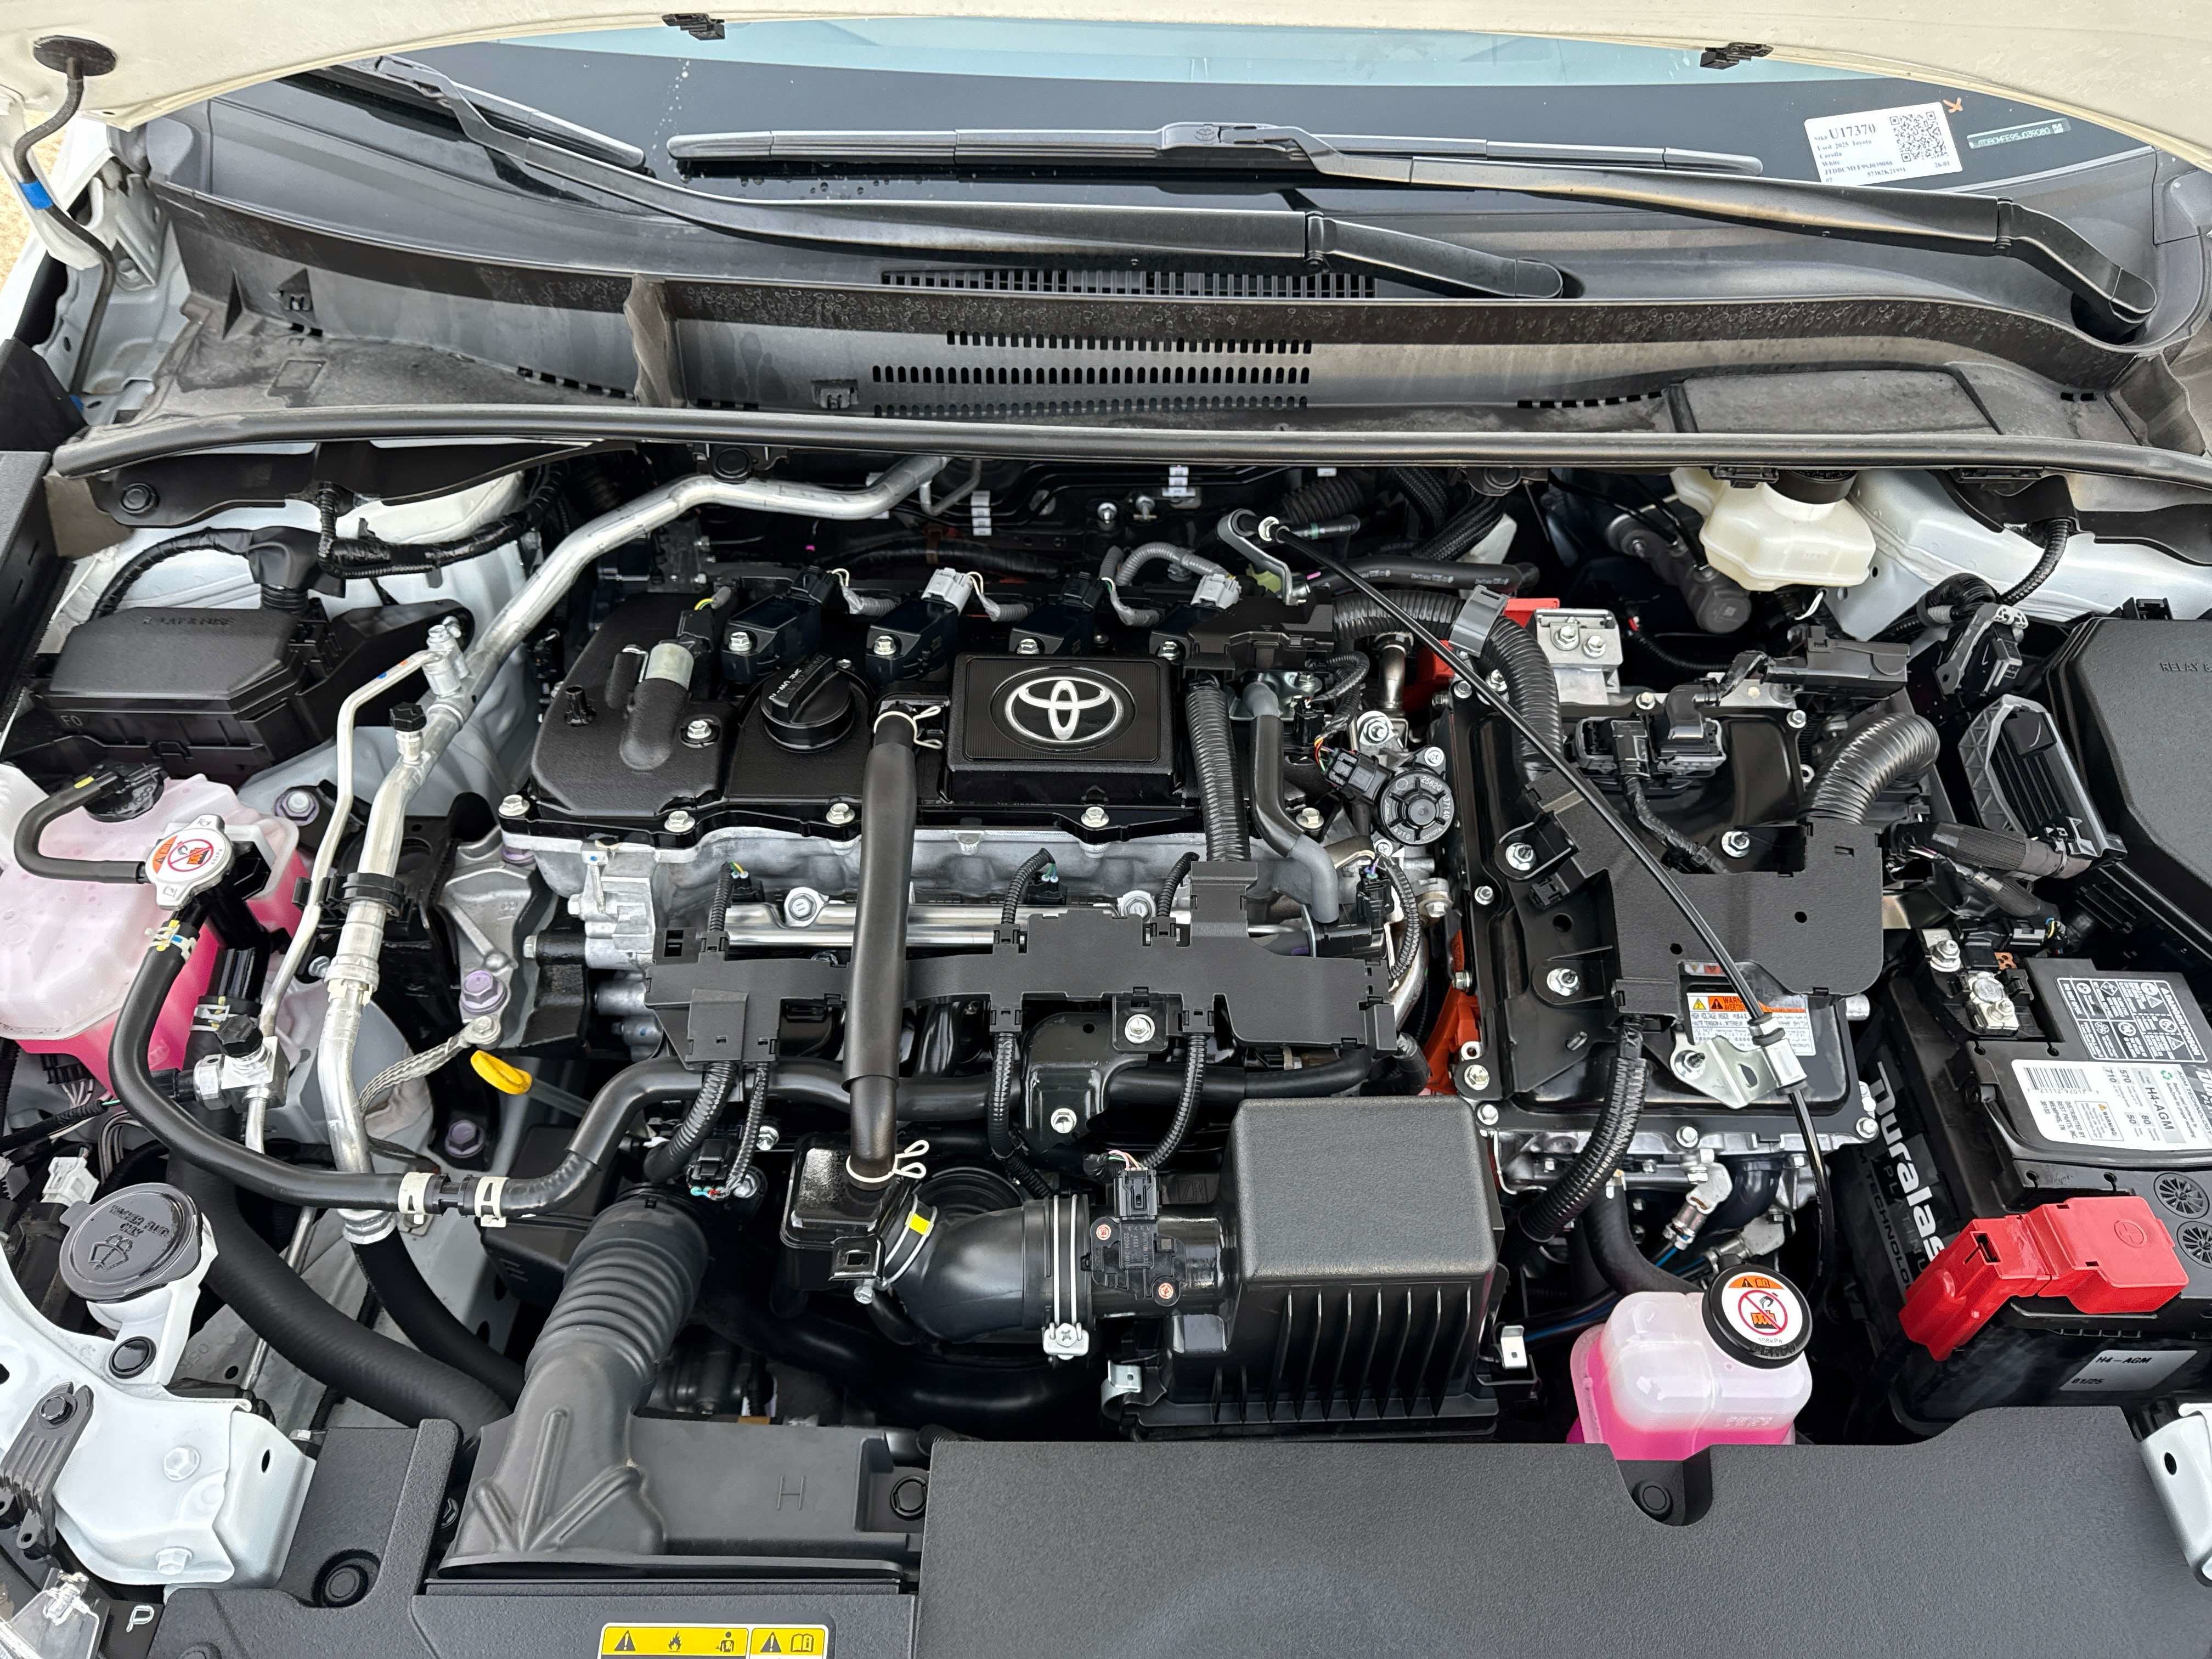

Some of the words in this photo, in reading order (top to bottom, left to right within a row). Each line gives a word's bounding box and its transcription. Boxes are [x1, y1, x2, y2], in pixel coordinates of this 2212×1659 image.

[1829, 123, 1876, 139] U17370
[1835, 141, 1849, 149] 2025
[1852, 139, 1872, 147] Toyota
[1819, 151, 1842, 159] Corolla
[2159, 662, 2198, 672] RELAY
[2203, 662, 2212, 672] &
[1420, 775, 1443, 792] 25620
[1442, 797, 1451, 820] 37140
[1421, 827, 1443, 841] TOYOTA
[2164, 994, 2201, 1056] DANGER/POISON
[2104, 1069, 2118, 1083] 710
[2119, 1069, 2132, 1084] 570
[2039, 1100, 2051, 1114] 38103
[2056, 1101, 2067, 1112] BEST
[2145, 1087, 2175, 1130] H4-AGM
[2176, 1069, 2188, 1087] AGM
[2186, 1088, 2212, 1135] TECHNOLOGY
[2048, 1101, 2063, 1124] MEMPHIS,
[2064, 1101, 2083, 1131] DISTRIBUTED
[2126, 1114, 2137, 1124] 50
[2141, 1114, 2152, 1125] 80
[2102, 1111, 2118, 1137] WARNING:
[1180, 1180, 1204, 1203] ZR
[119, 1222, 144, 1238] ONLY
[1751, 1342, 1797, 1357] DENSO
[776, 1474, 807, 1511] H
[126, 1605, 155, 1633] P
